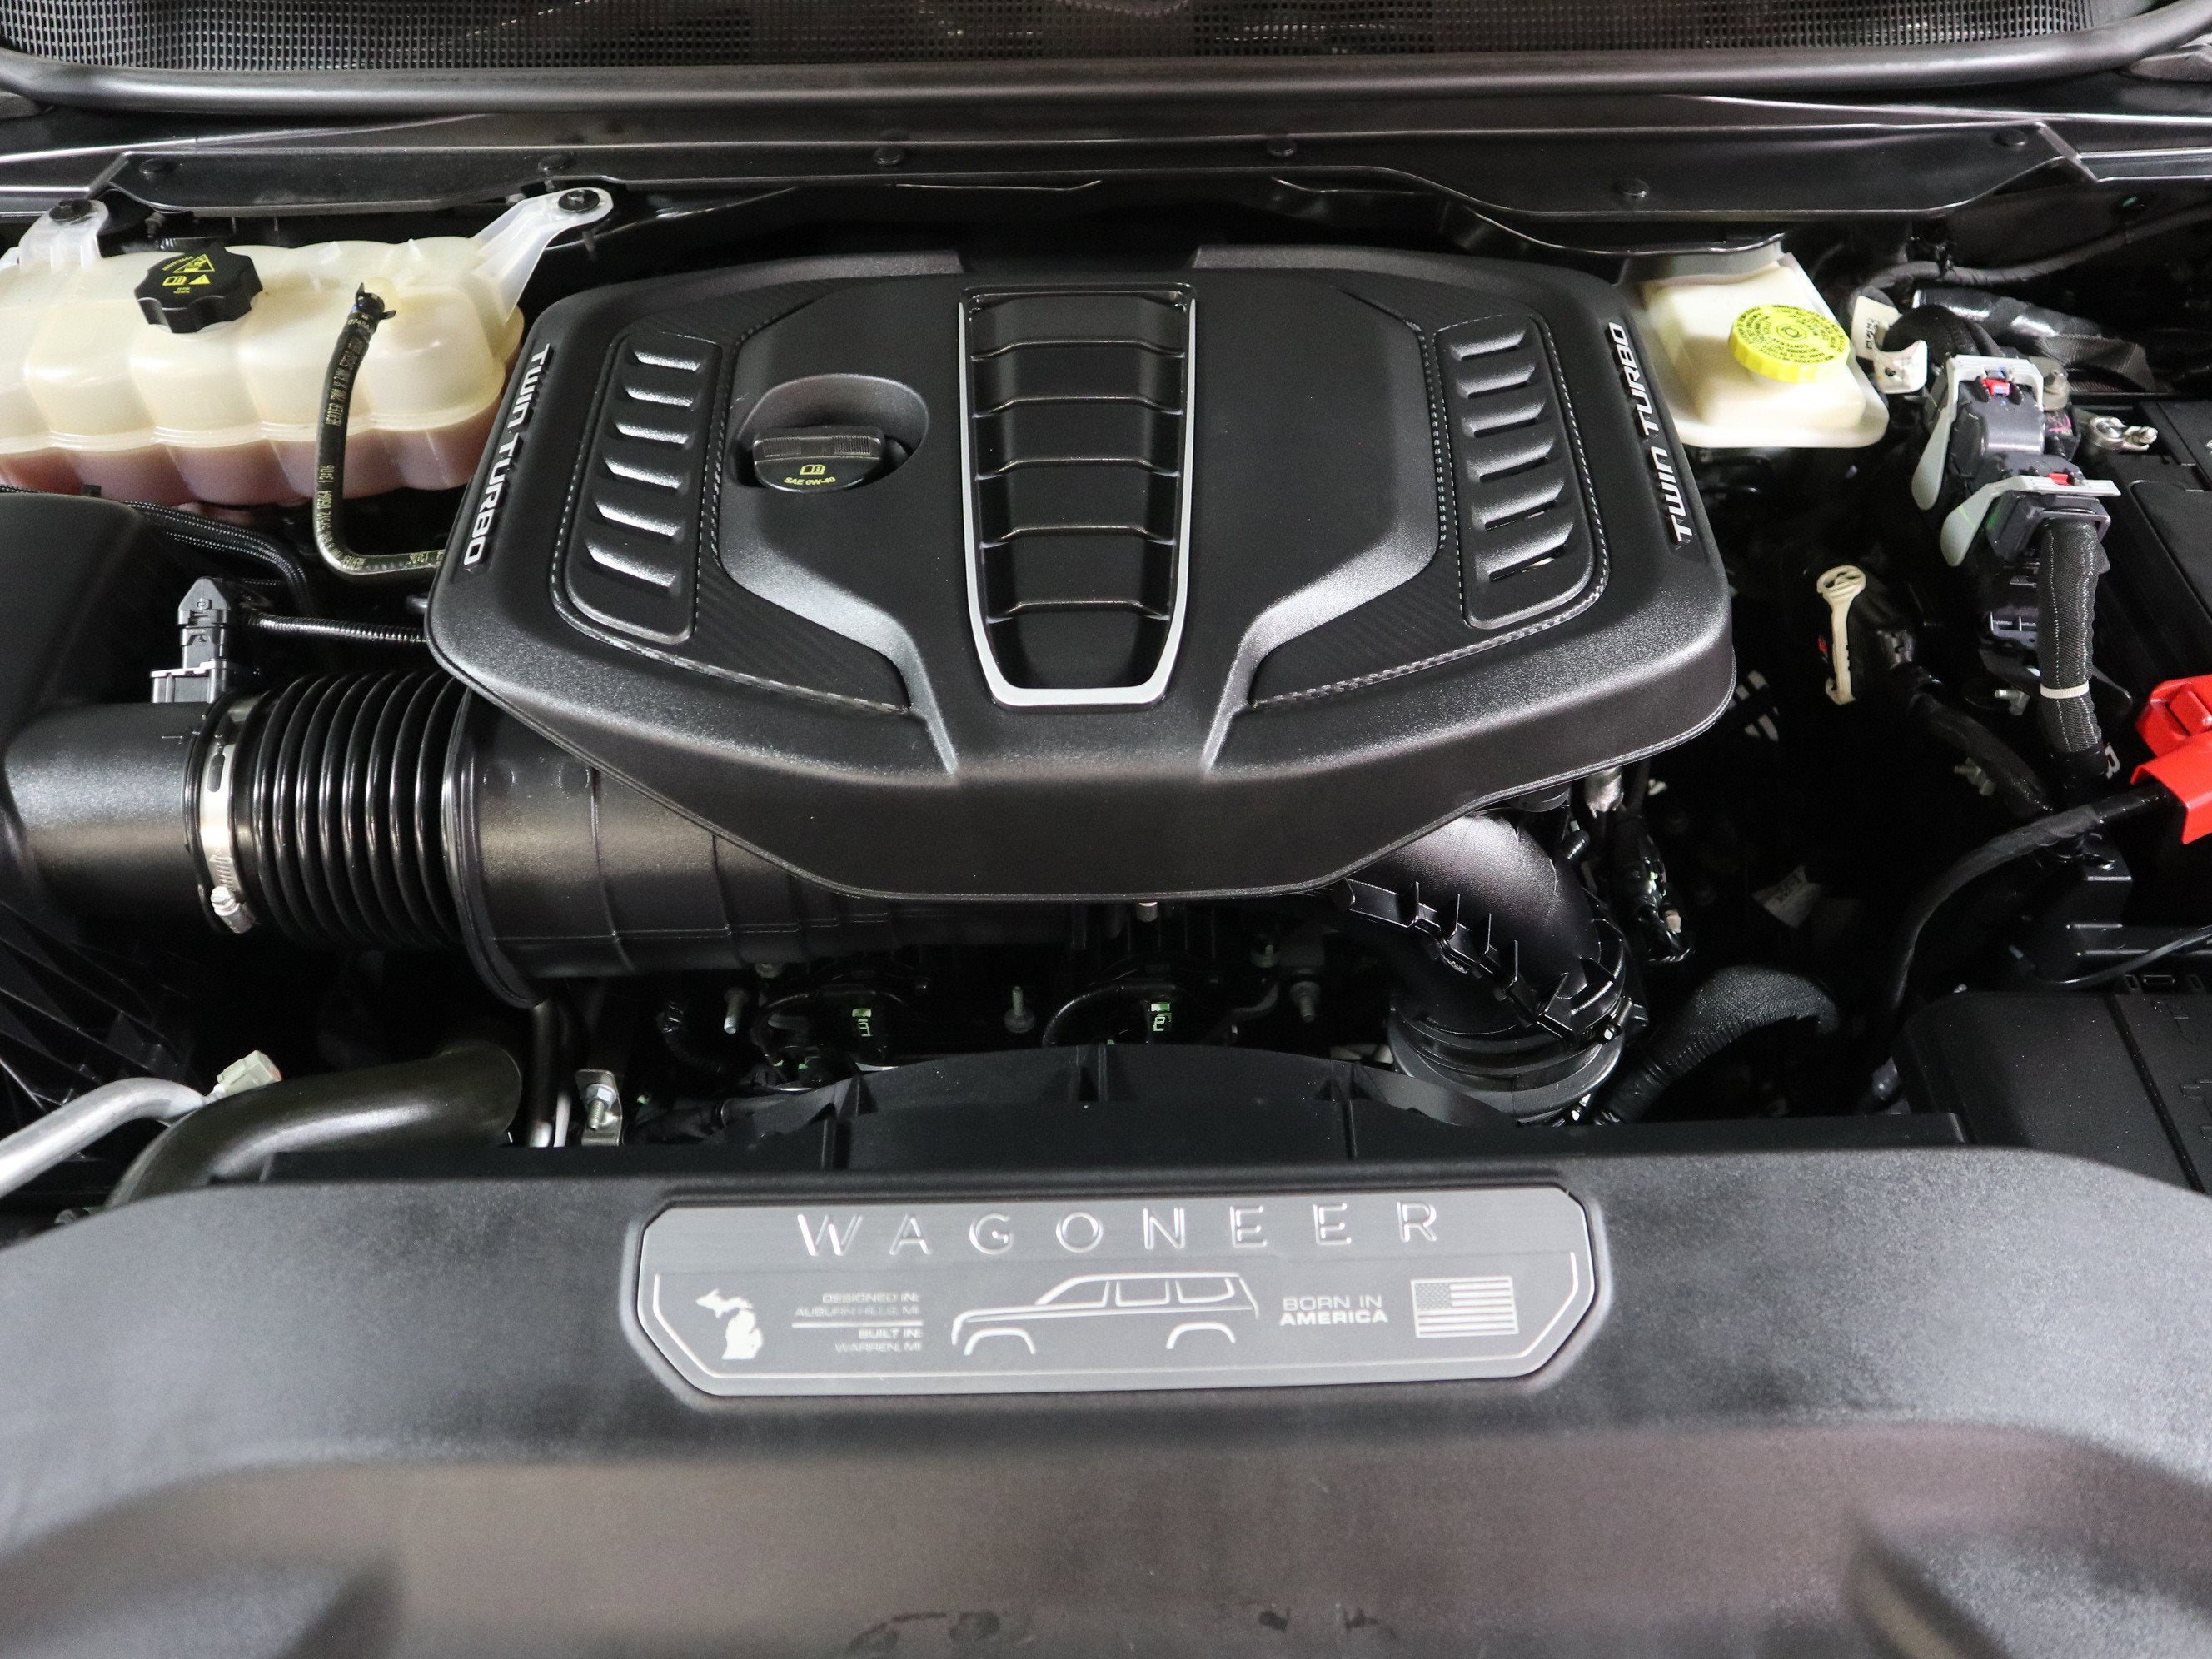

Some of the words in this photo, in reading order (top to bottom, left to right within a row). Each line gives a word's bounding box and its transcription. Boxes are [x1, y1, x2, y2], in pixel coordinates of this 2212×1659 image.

[507, 343, 550, 428] TWIN
[1609, 322, 1659, 436] TURBO
[463, 433, 519, 566] TURBO
[784, 477, 805, 486] SAE
[805, 476, 836, 486] 0W-40
[1651, 446, 1692, 542] TWIN
[796, 1201, 1438, 1258] WAGONEER
[1279, 1308, 1388, 1326] AMERICA
[1283, 1294, 1350, 1311] BORN
[1359, 1293, 1382, 1308] IN
[858, 1327, 900, 1339] BUILT
[904, 1341, 921, 1351] MI
